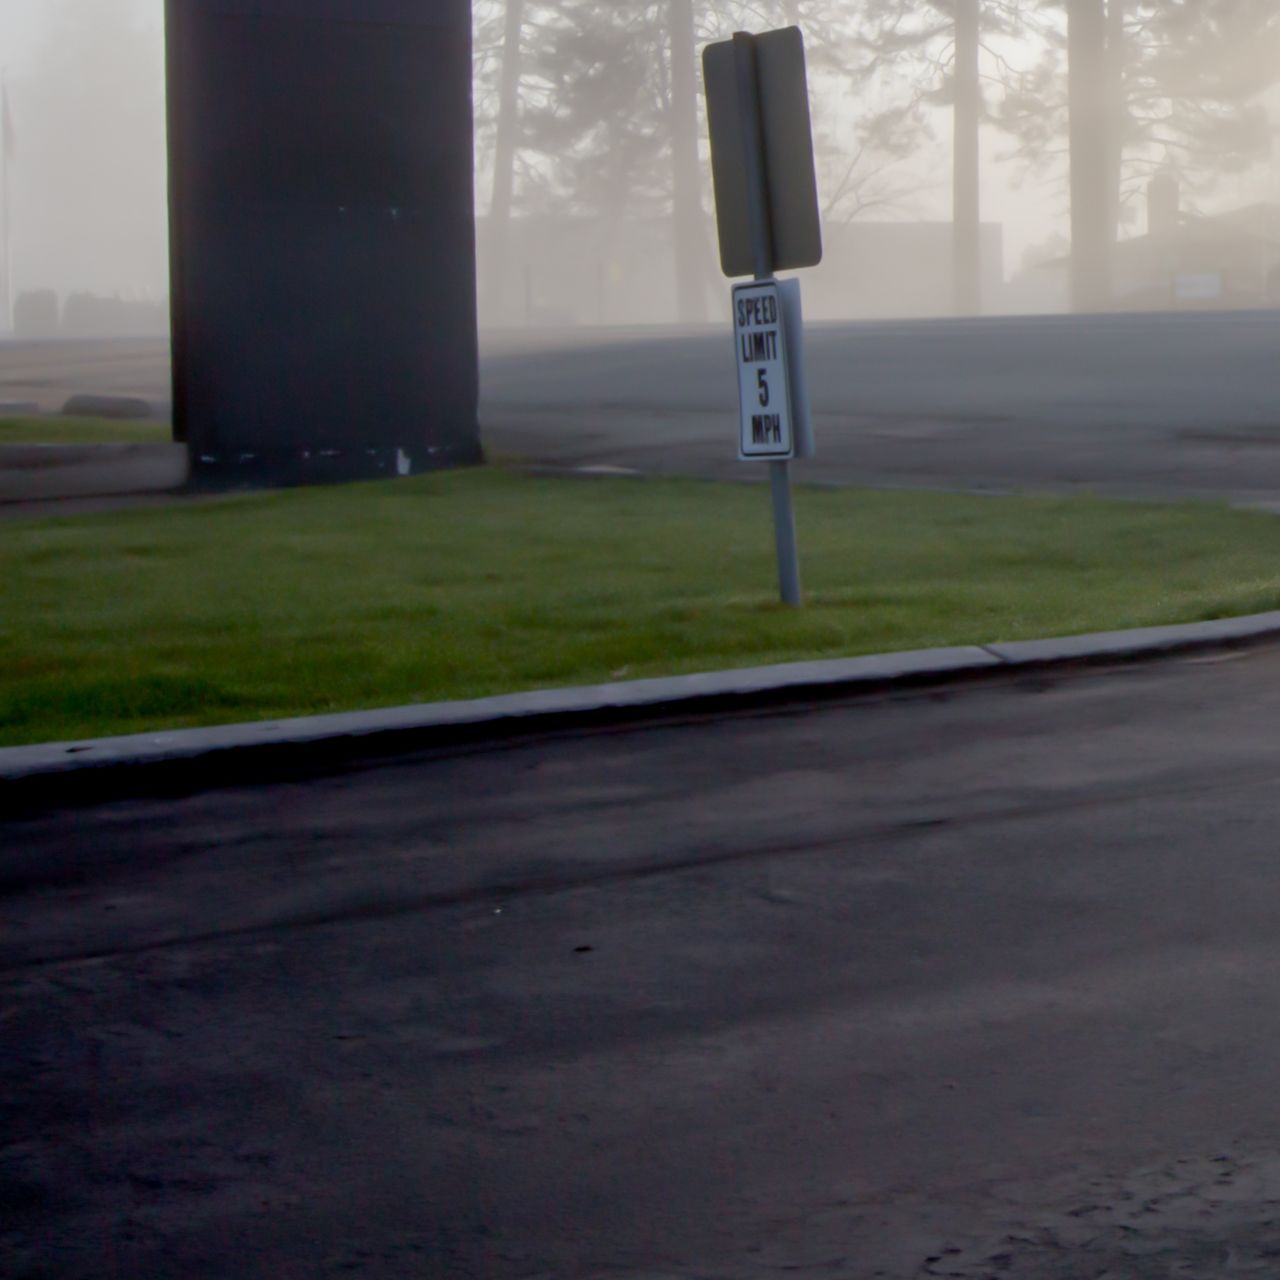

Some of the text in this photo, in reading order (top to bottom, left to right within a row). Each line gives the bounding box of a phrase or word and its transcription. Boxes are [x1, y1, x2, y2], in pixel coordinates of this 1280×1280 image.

[737, 295, 777, 327] SPEED
[740, 330, 777, 363] LIMIT
[757, 368, 769, 407] 5
[751, 414, 782, 444] MPH
